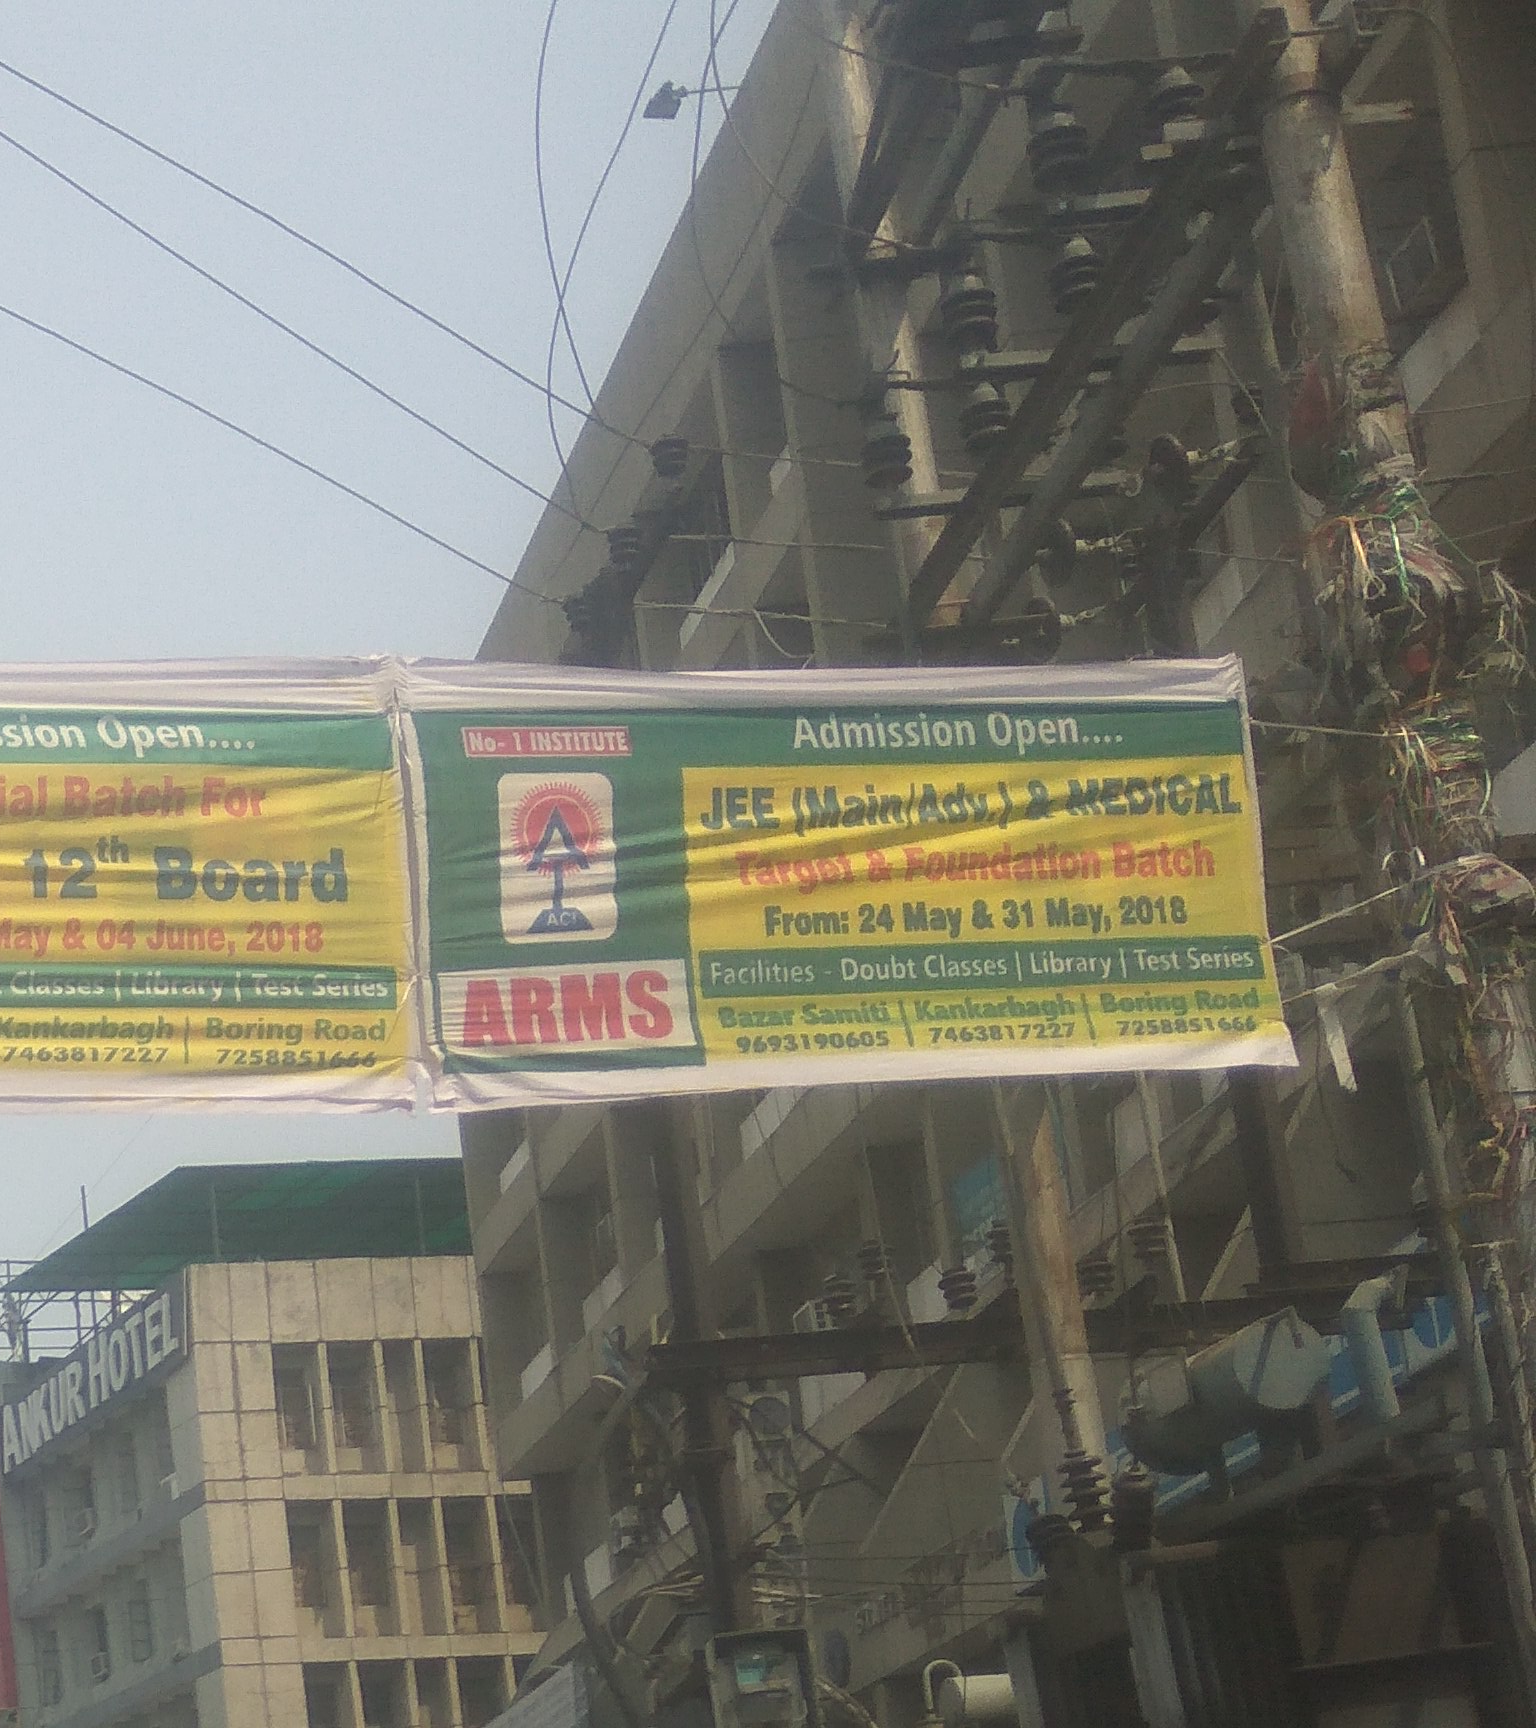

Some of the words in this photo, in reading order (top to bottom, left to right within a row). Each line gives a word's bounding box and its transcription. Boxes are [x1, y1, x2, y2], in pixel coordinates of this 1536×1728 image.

[710, 962, 814, 986] Facilities
[841, 956, 917, 982] Doubt
[924, 954, 1007, 978] Classes
[1031, 950, 1112, 978] Library
[1136, 949, 1182, 971] Test
[1187, 947, 1255, 970] Series
[205, 1017, 303, 1045] Boring
[314, 1019, 386, 1042] Road
[462, 970, 674, 1048] ARMS
[3, 1360, 86, 1474] ANKUR
[88, 1294, 178, 1409] HOTEL
